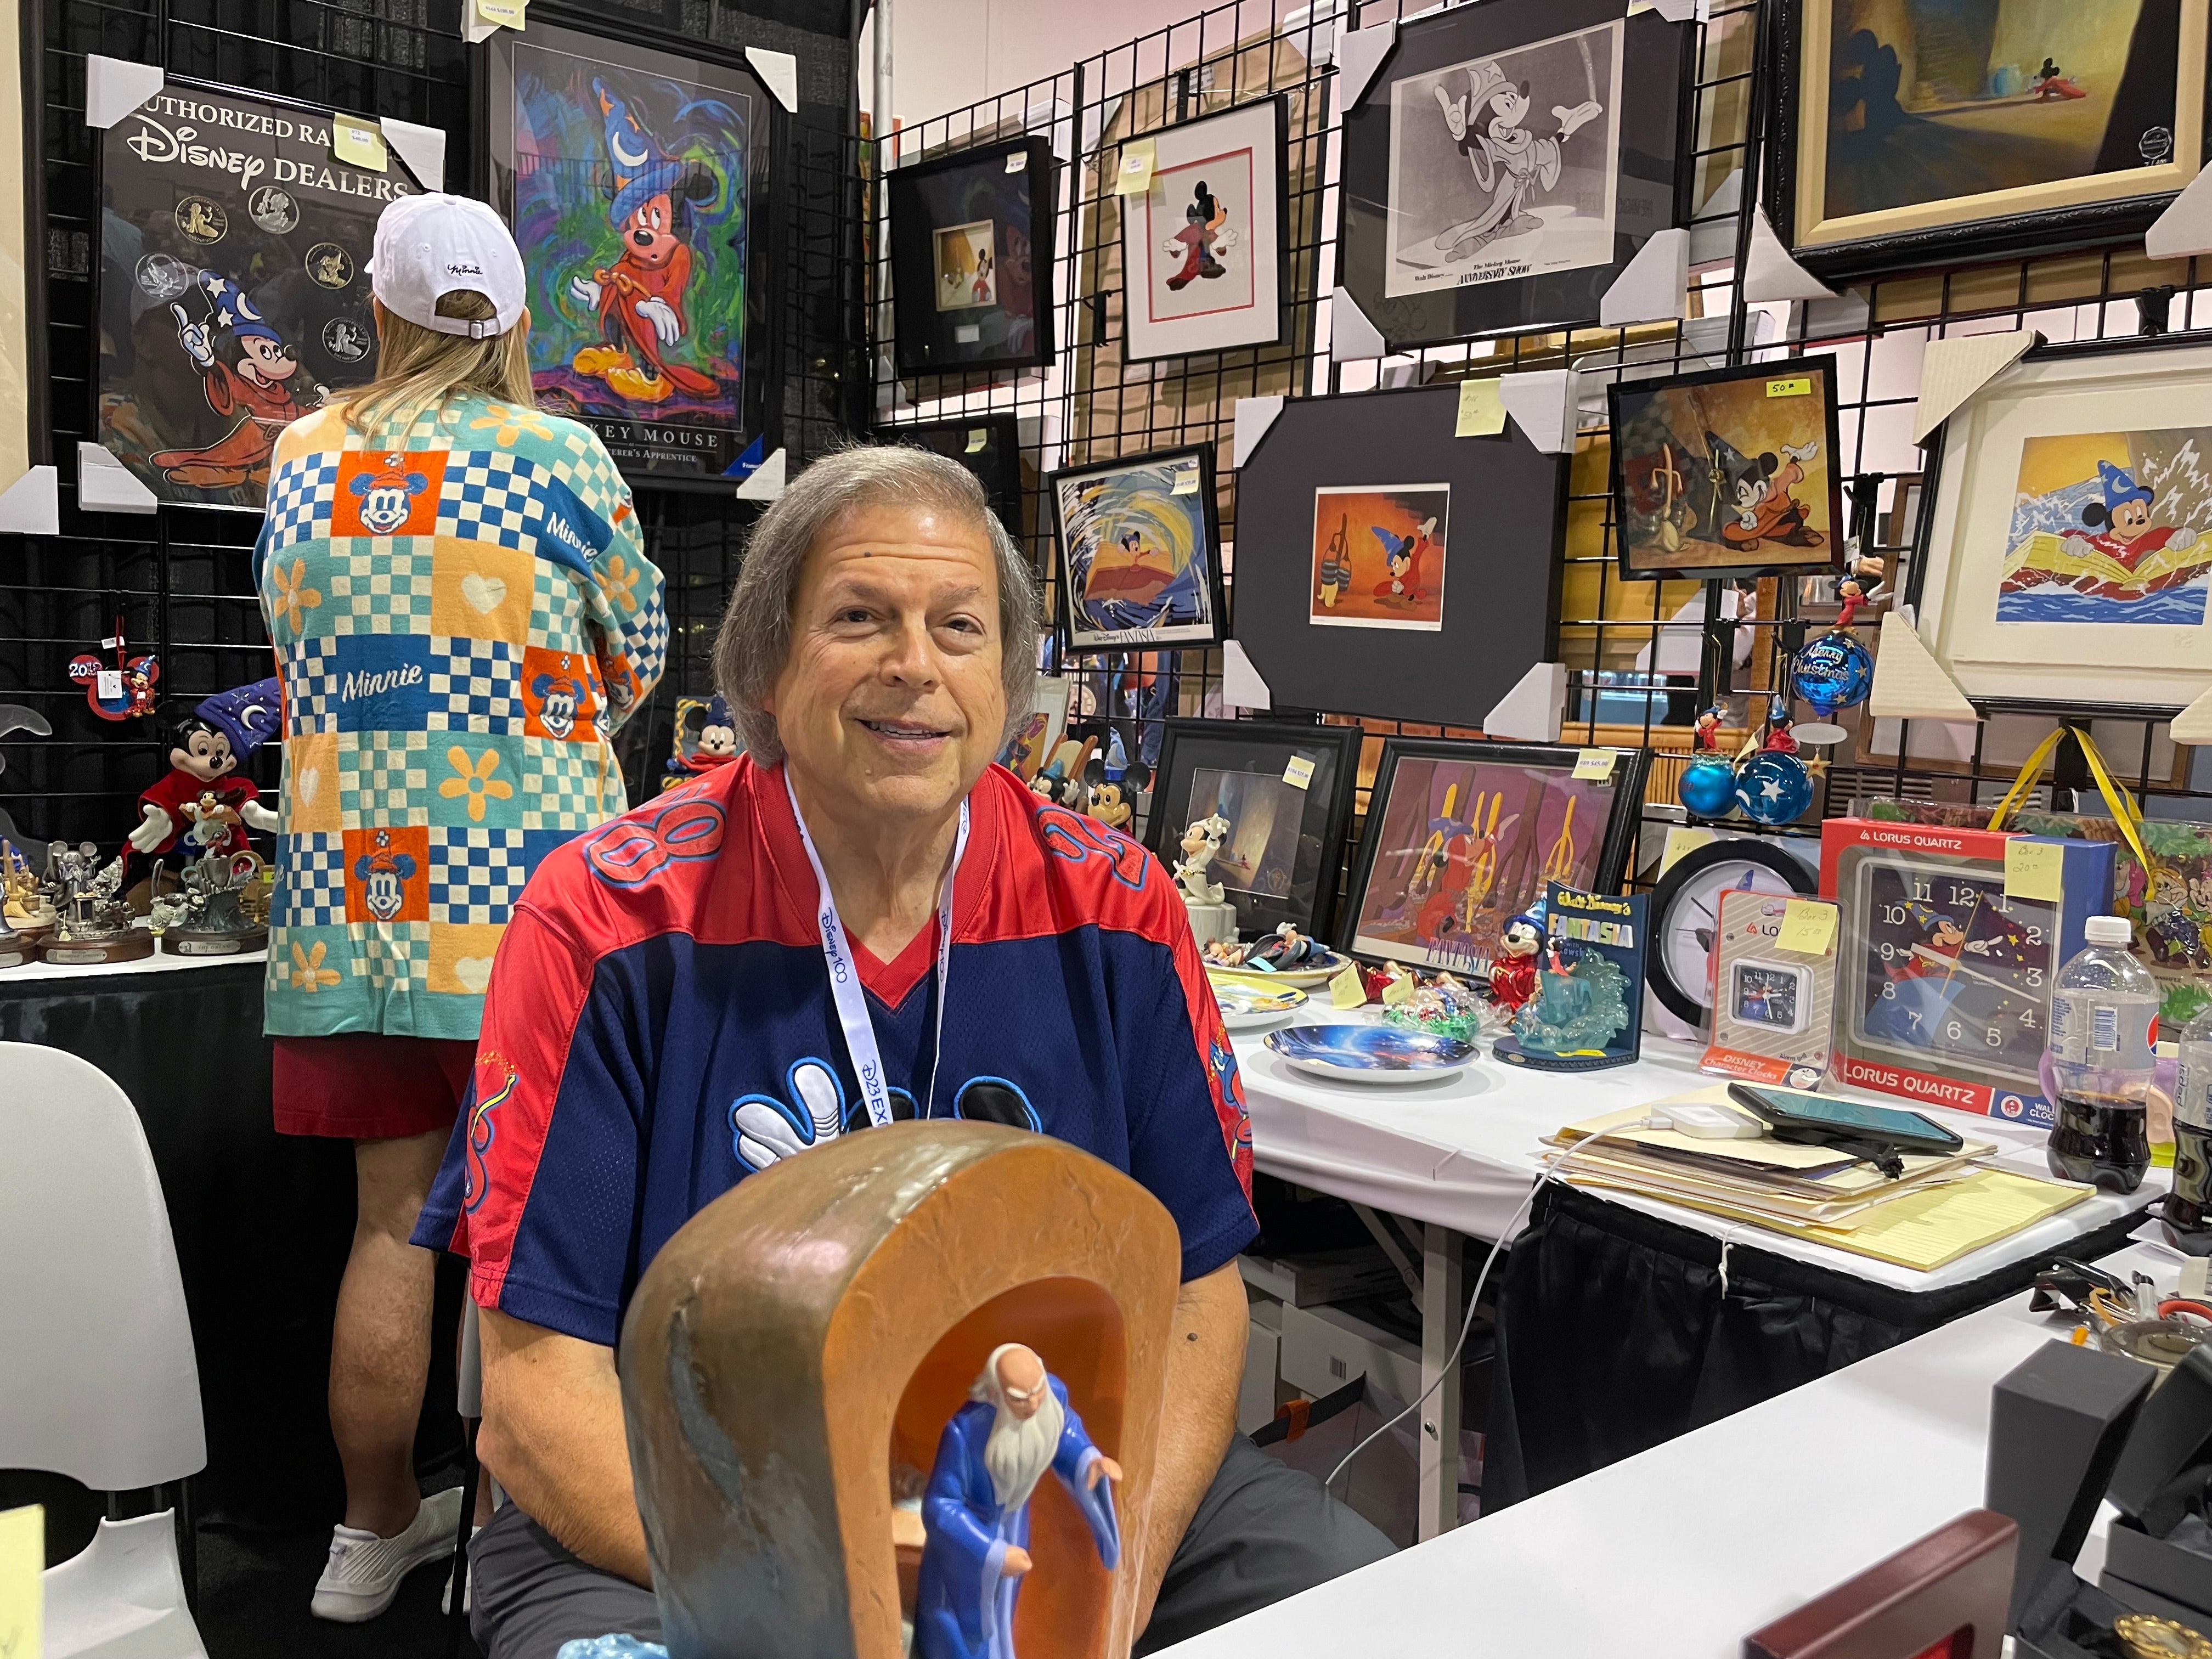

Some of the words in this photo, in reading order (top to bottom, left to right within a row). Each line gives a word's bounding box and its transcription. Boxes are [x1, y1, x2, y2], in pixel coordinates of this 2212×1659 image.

[139, 95, 294, 138] UTHORIZED
[447, 264, 483, 276] Minnie
[590, 423, 630, 439] KEY
[644, 428, 718, 448] MOUSE
[546, 511, 599, 563] Minnie
[1120, 629, 1155, 644] FANTASIA
[1791, 652, 1849, 681] Christmas
[1800, 645, 1844, 665] Merry
[342, 663, 423, 703] Minnie
[1873, 831, 1911, 845] LORUS
[1914, 836, 1962, 850] QUARTZ
[1913, 881, 1933, 902] 11
[1949, 885, 1975, 907] 12
[1999, 893, 2010, 913] 1
[1548, 913, 1634, 949] FANTASIA
[1819, 910, 1829, 921] 3
[1882, 904, 1906, 926] 10
[2025, 926, 2042, 946] 2
[1426, 936, 1491, 975] FANTASIA
[1880, 942, 1894, 961] 9
[2025, 967, 2043, 987] 3
[1882, 981, 1897, 1000] 8
[2019, 1008, 2036, 1029] 4
[1908, 1011, 1923, 1030] 7
[1946, 1021, 1962, 1040] 6
[1985, 1027, 2002, 1047] 5
[861, 1059, 881, 1097] D23
[1704, 1057, 1748, 1073] Character
[1748, 1068, 1778, 1080] Clocks
[1722, 1054, 1767, 1070] DISNEY
[1843, 1065, 1898, 1087] LORUS
[1903, 1076, 1976, 1104] QUARTZ
[2029, 1108, 2054, 1121] CLOC
